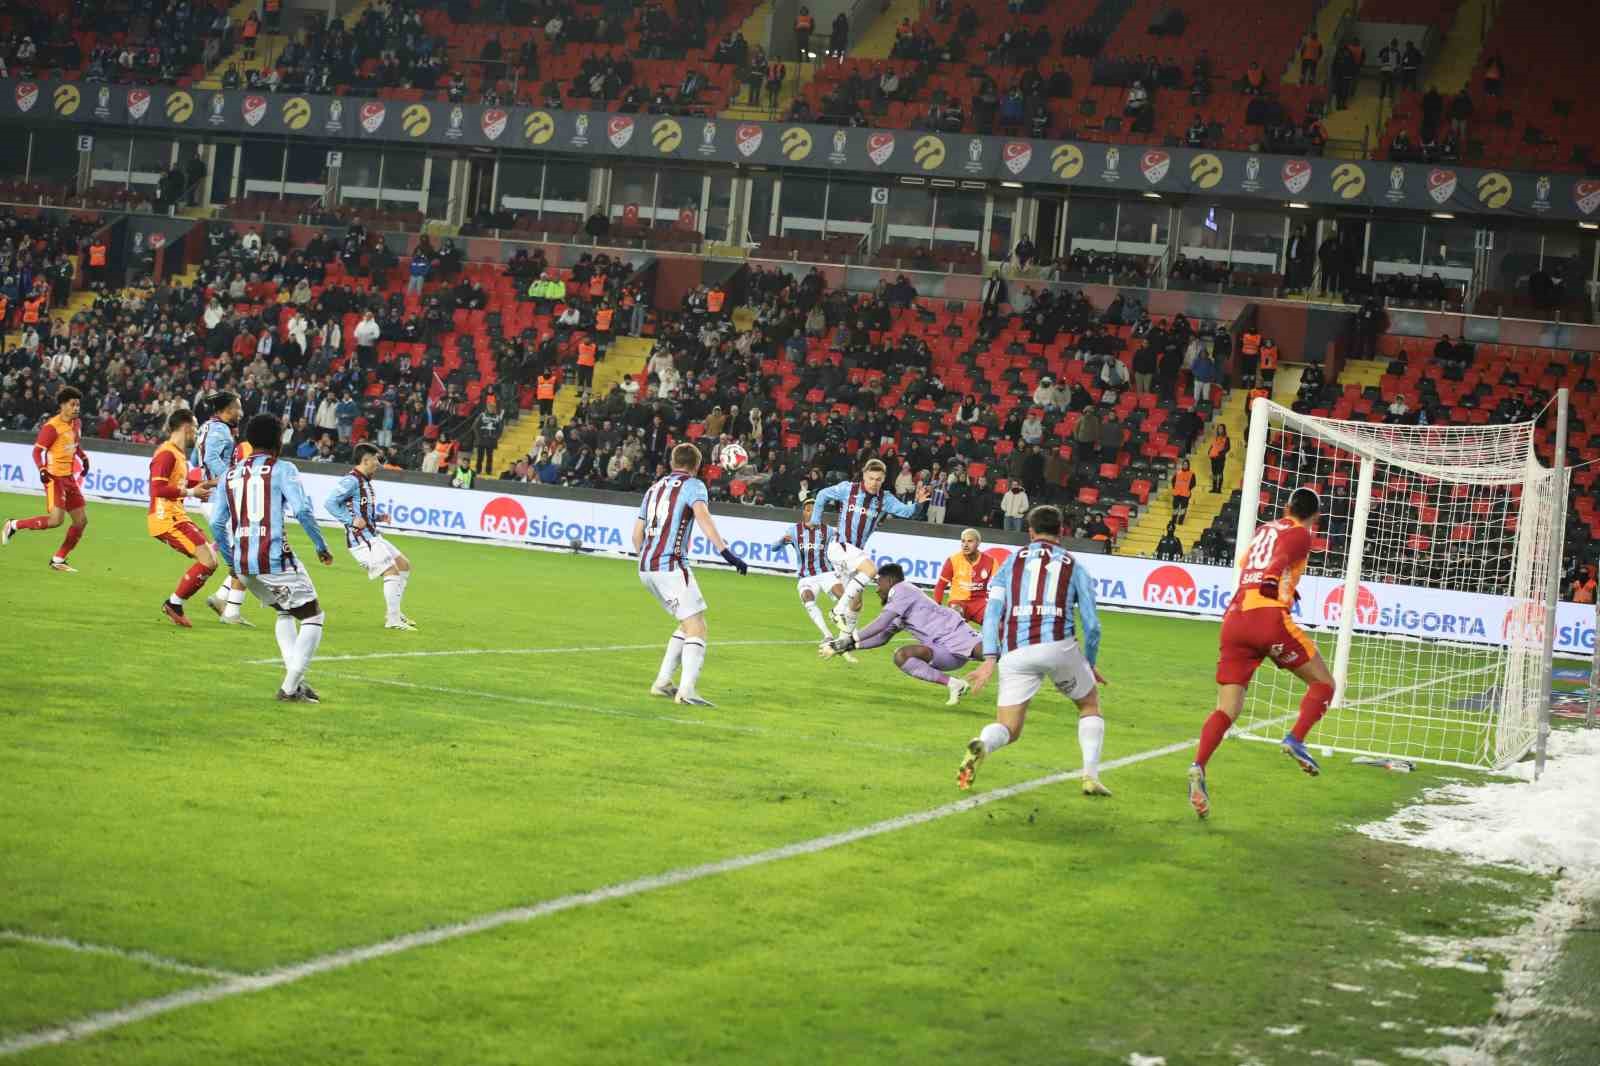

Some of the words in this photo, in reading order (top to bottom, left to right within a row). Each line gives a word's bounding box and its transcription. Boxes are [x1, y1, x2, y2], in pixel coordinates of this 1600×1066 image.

[80, 138, 90, 150] E
[330, 154, 340, 166] F
[874, 190, 886, 204] G
[85, 469, 145, 495] SİGOR
[482, 514, 526, 537] RAY
[1026, 558, 1062, 602] 11
[1147, 583, 1195, 608] RAY
